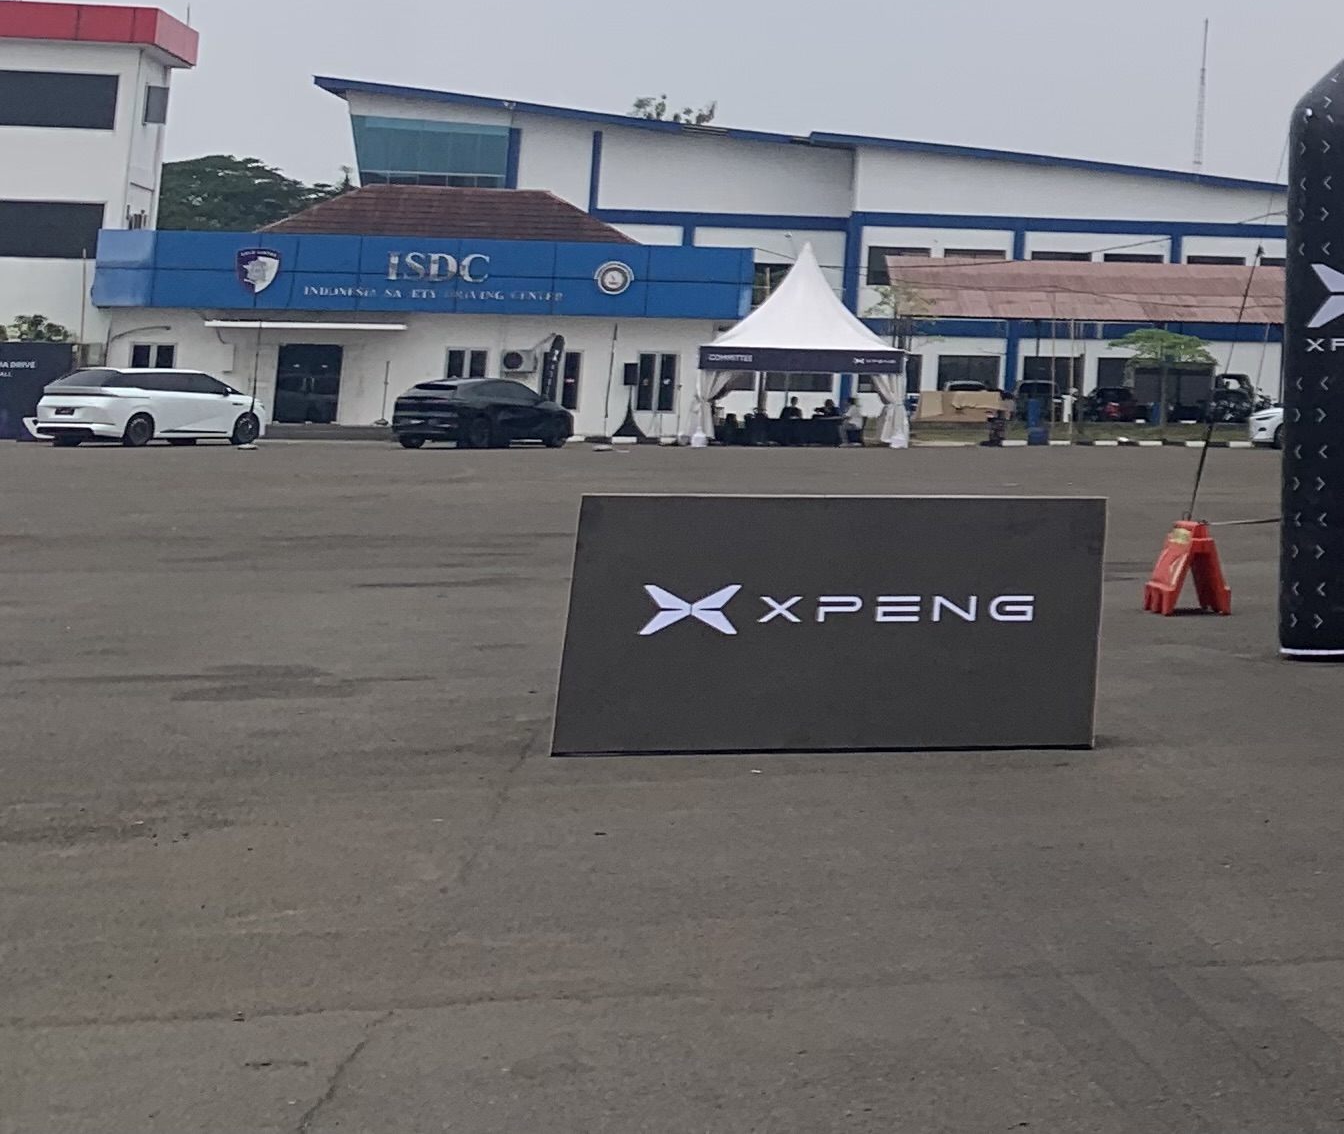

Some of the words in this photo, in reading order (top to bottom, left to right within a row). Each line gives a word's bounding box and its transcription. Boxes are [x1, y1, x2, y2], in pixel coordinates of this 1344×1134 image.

[386, 251, 490, 283] ISDC
[303, 286, 377, 298] INDONESIA
[384, 288, 437, 299] SAETY
[757, 595, 1035, 623] XPENG
